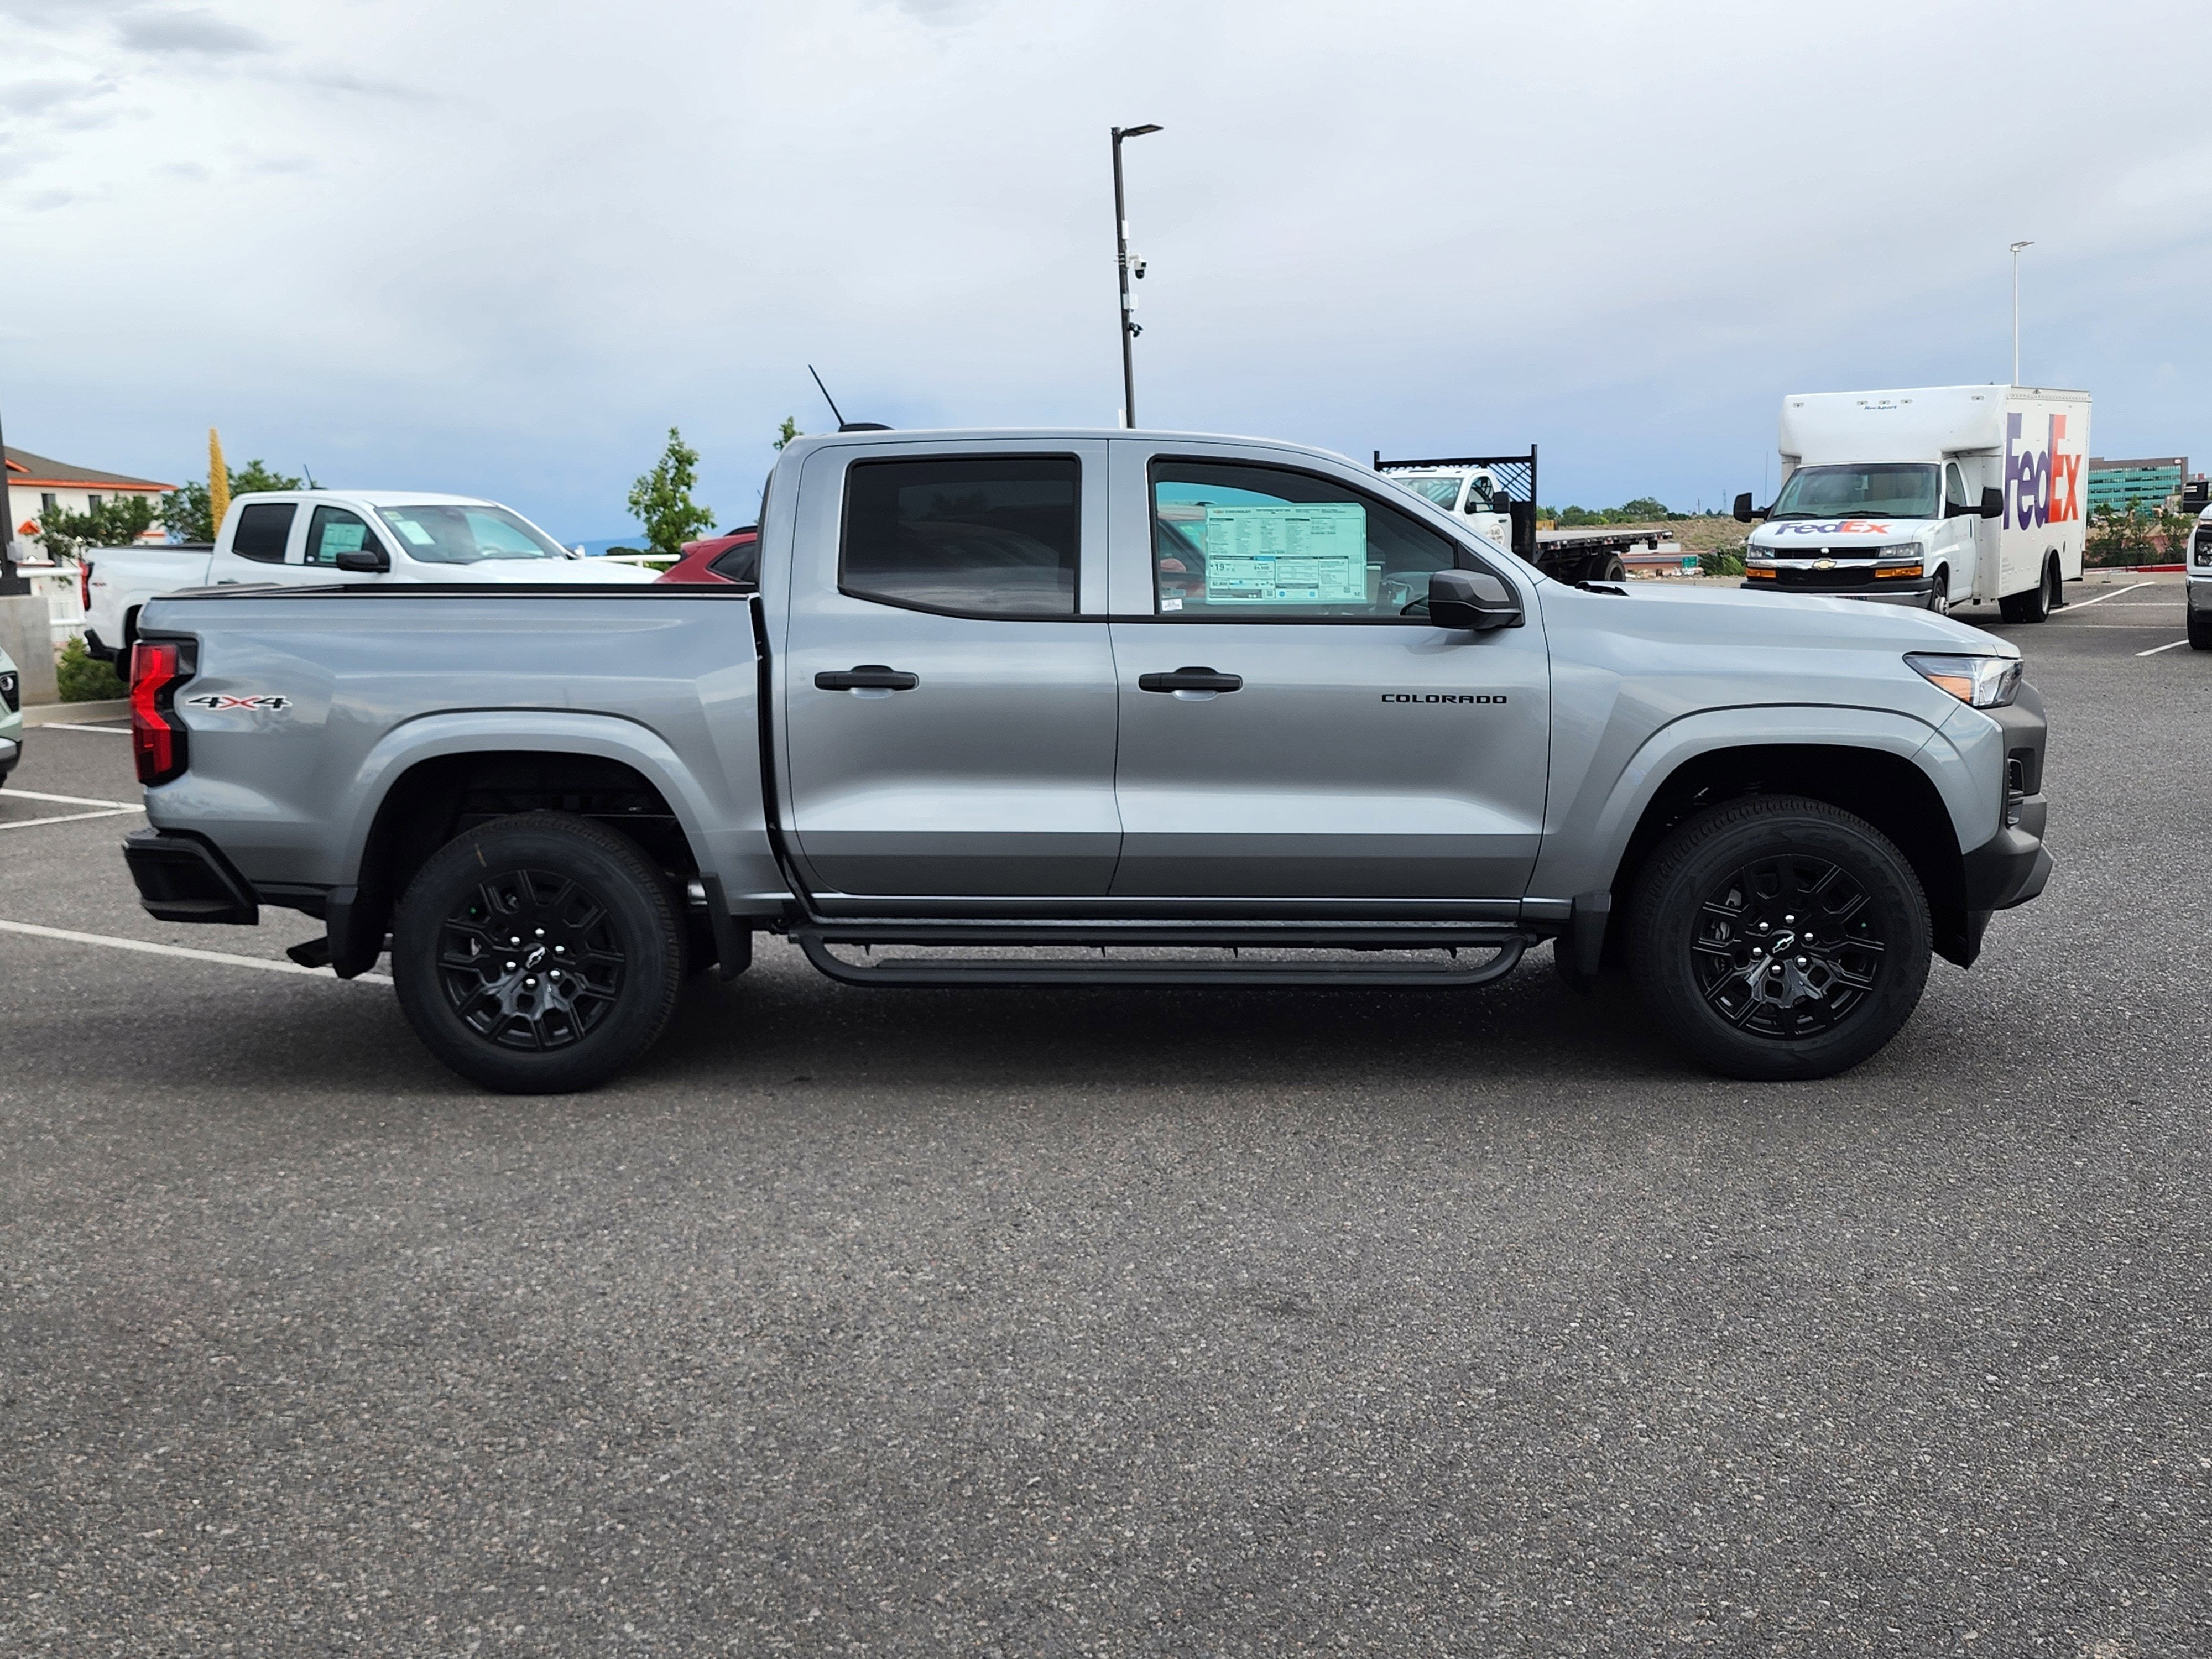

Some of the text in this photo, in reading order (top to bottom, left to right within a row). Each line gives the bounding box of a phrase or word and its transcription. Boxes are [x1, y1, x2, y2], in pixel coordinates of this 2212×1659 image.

[2003, 412, 2082, 531] FedEx
[1775, 519, 1893, 536] FedEx
[1381, 694, 1507, 704] COLORADO
